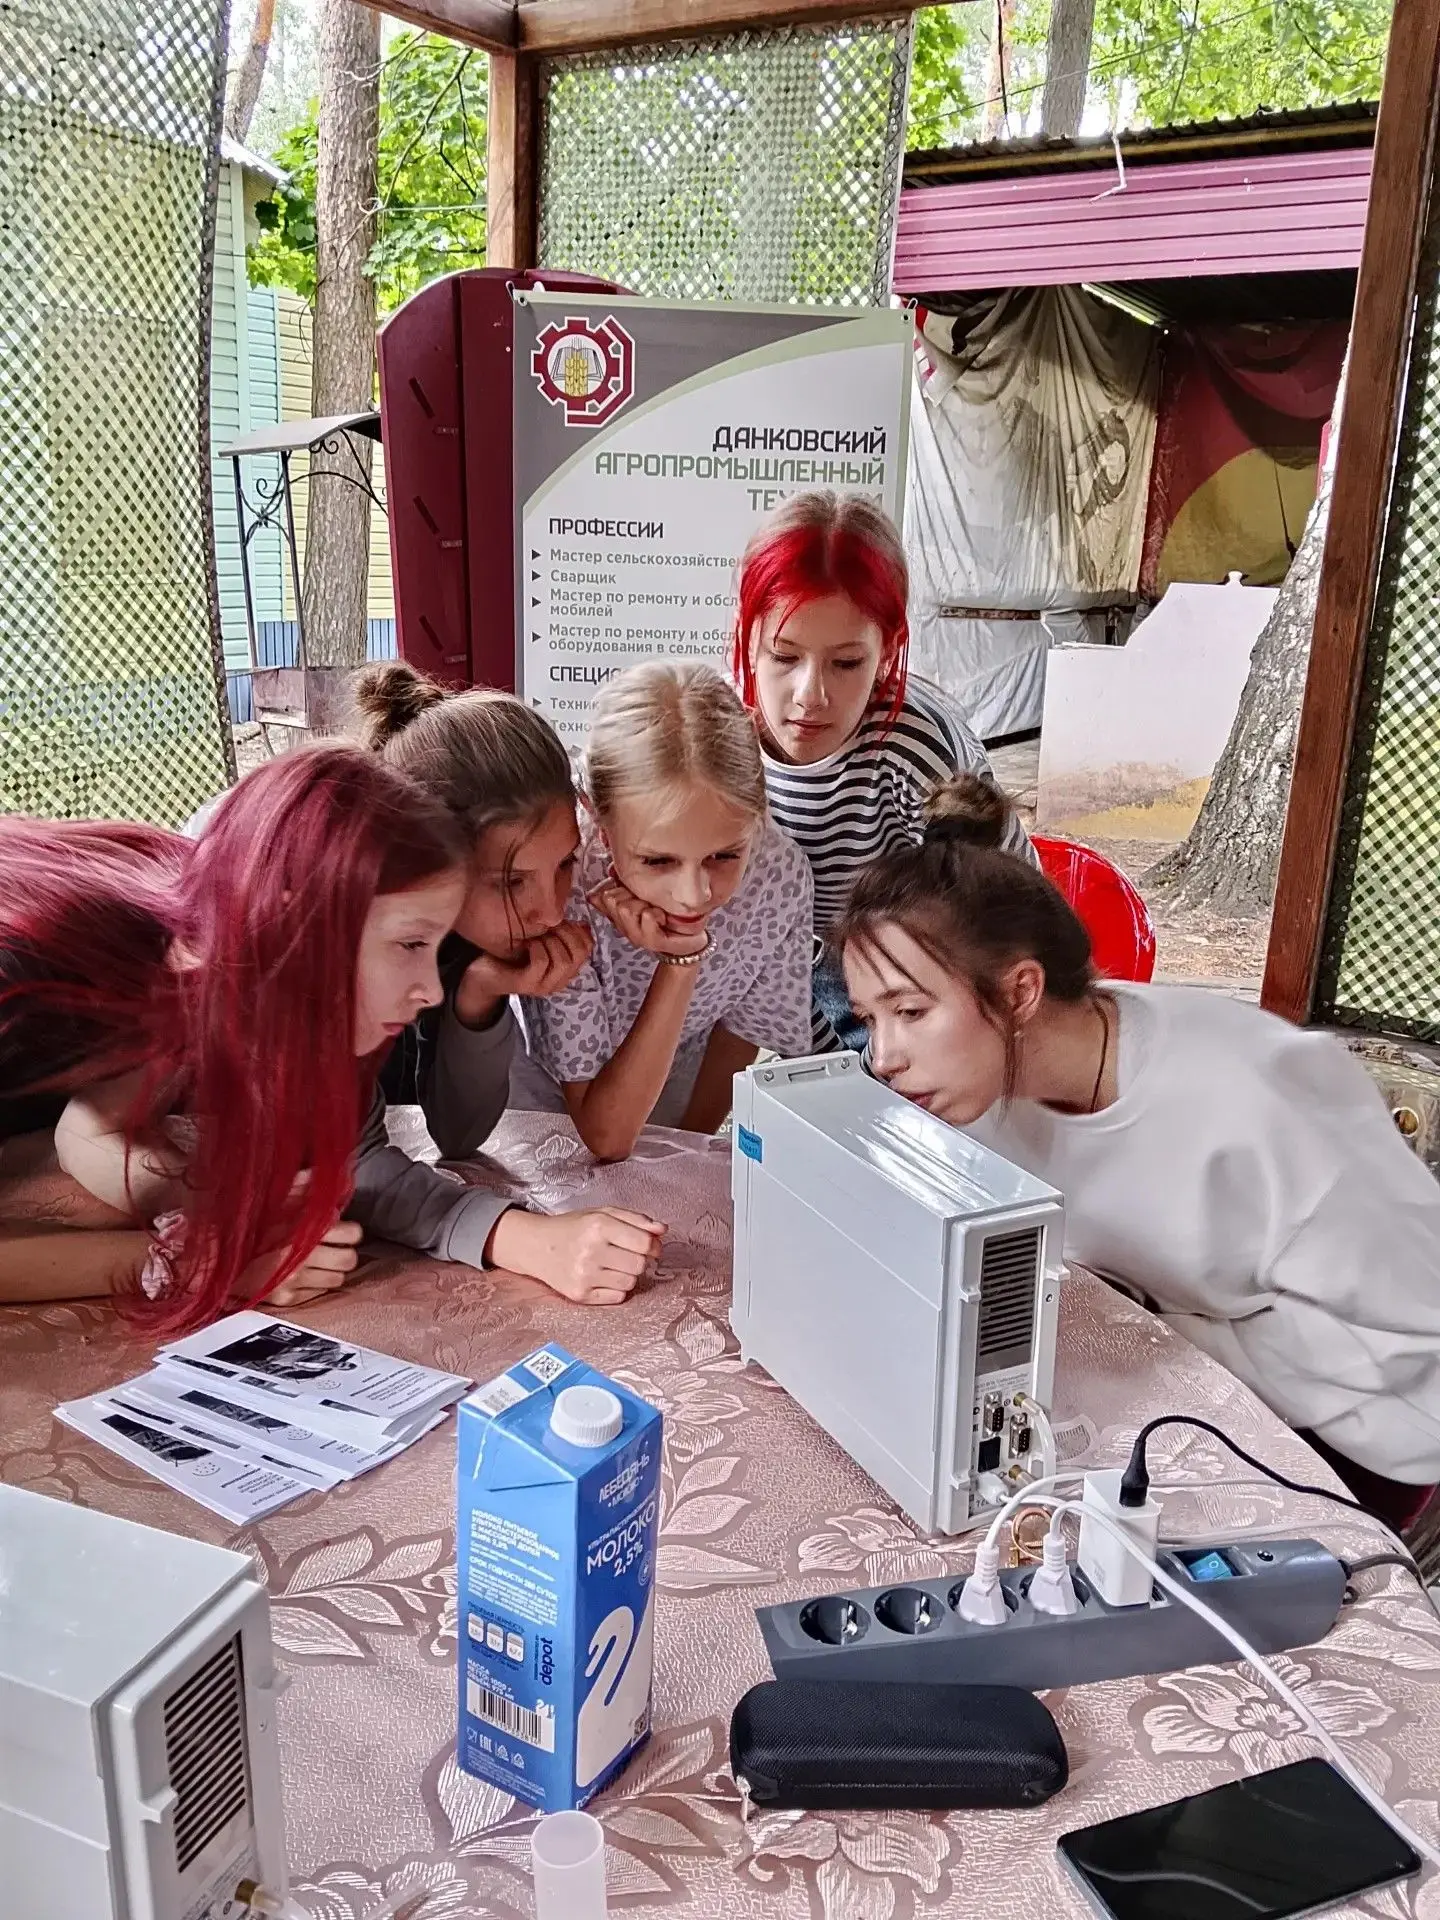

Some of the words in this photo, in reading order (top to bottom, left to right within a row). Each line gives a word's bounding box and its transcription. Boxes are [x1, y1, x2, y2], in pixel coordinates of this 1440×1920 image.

[712, 426, 886, 454] ДАНКОВСКИЙ
[595, 452, 885, 485] АГРОПРОМЫШЛЕННЫЙ
[549, 518, 664, 538] ПРОФЕССИИ
[550, 549, 602, 564] Мастер
[550, 569, 617, 585] Сварщик
[550, 589, 602, 604] Мастер
[606, 592, 624, 603] по
[628, 593, 688, 608] ремонту
[692, 596, 701, 606] и
[705, 594, 738, 607] обсл
[550, 604, 613, 617] мобилей
[549, 623, 600, 639] Мастер
[605, 627, 622, 638] по
[626, 628, 686, 642] ремонту
[690, 631, 698, 640] и
[549, 639, 653, 653] оборудования
[657, 643, 665, 653] в
[550, 720, 592, 732] Техно
[598, 1454, 650, 1503] ЛЕБЕДЯНЬ
[586, 1501, 656, 1576] МОЛОКО
[614, 1537, 644, 1577] 2,5%
[539, 1637, 556, 1686] depot
